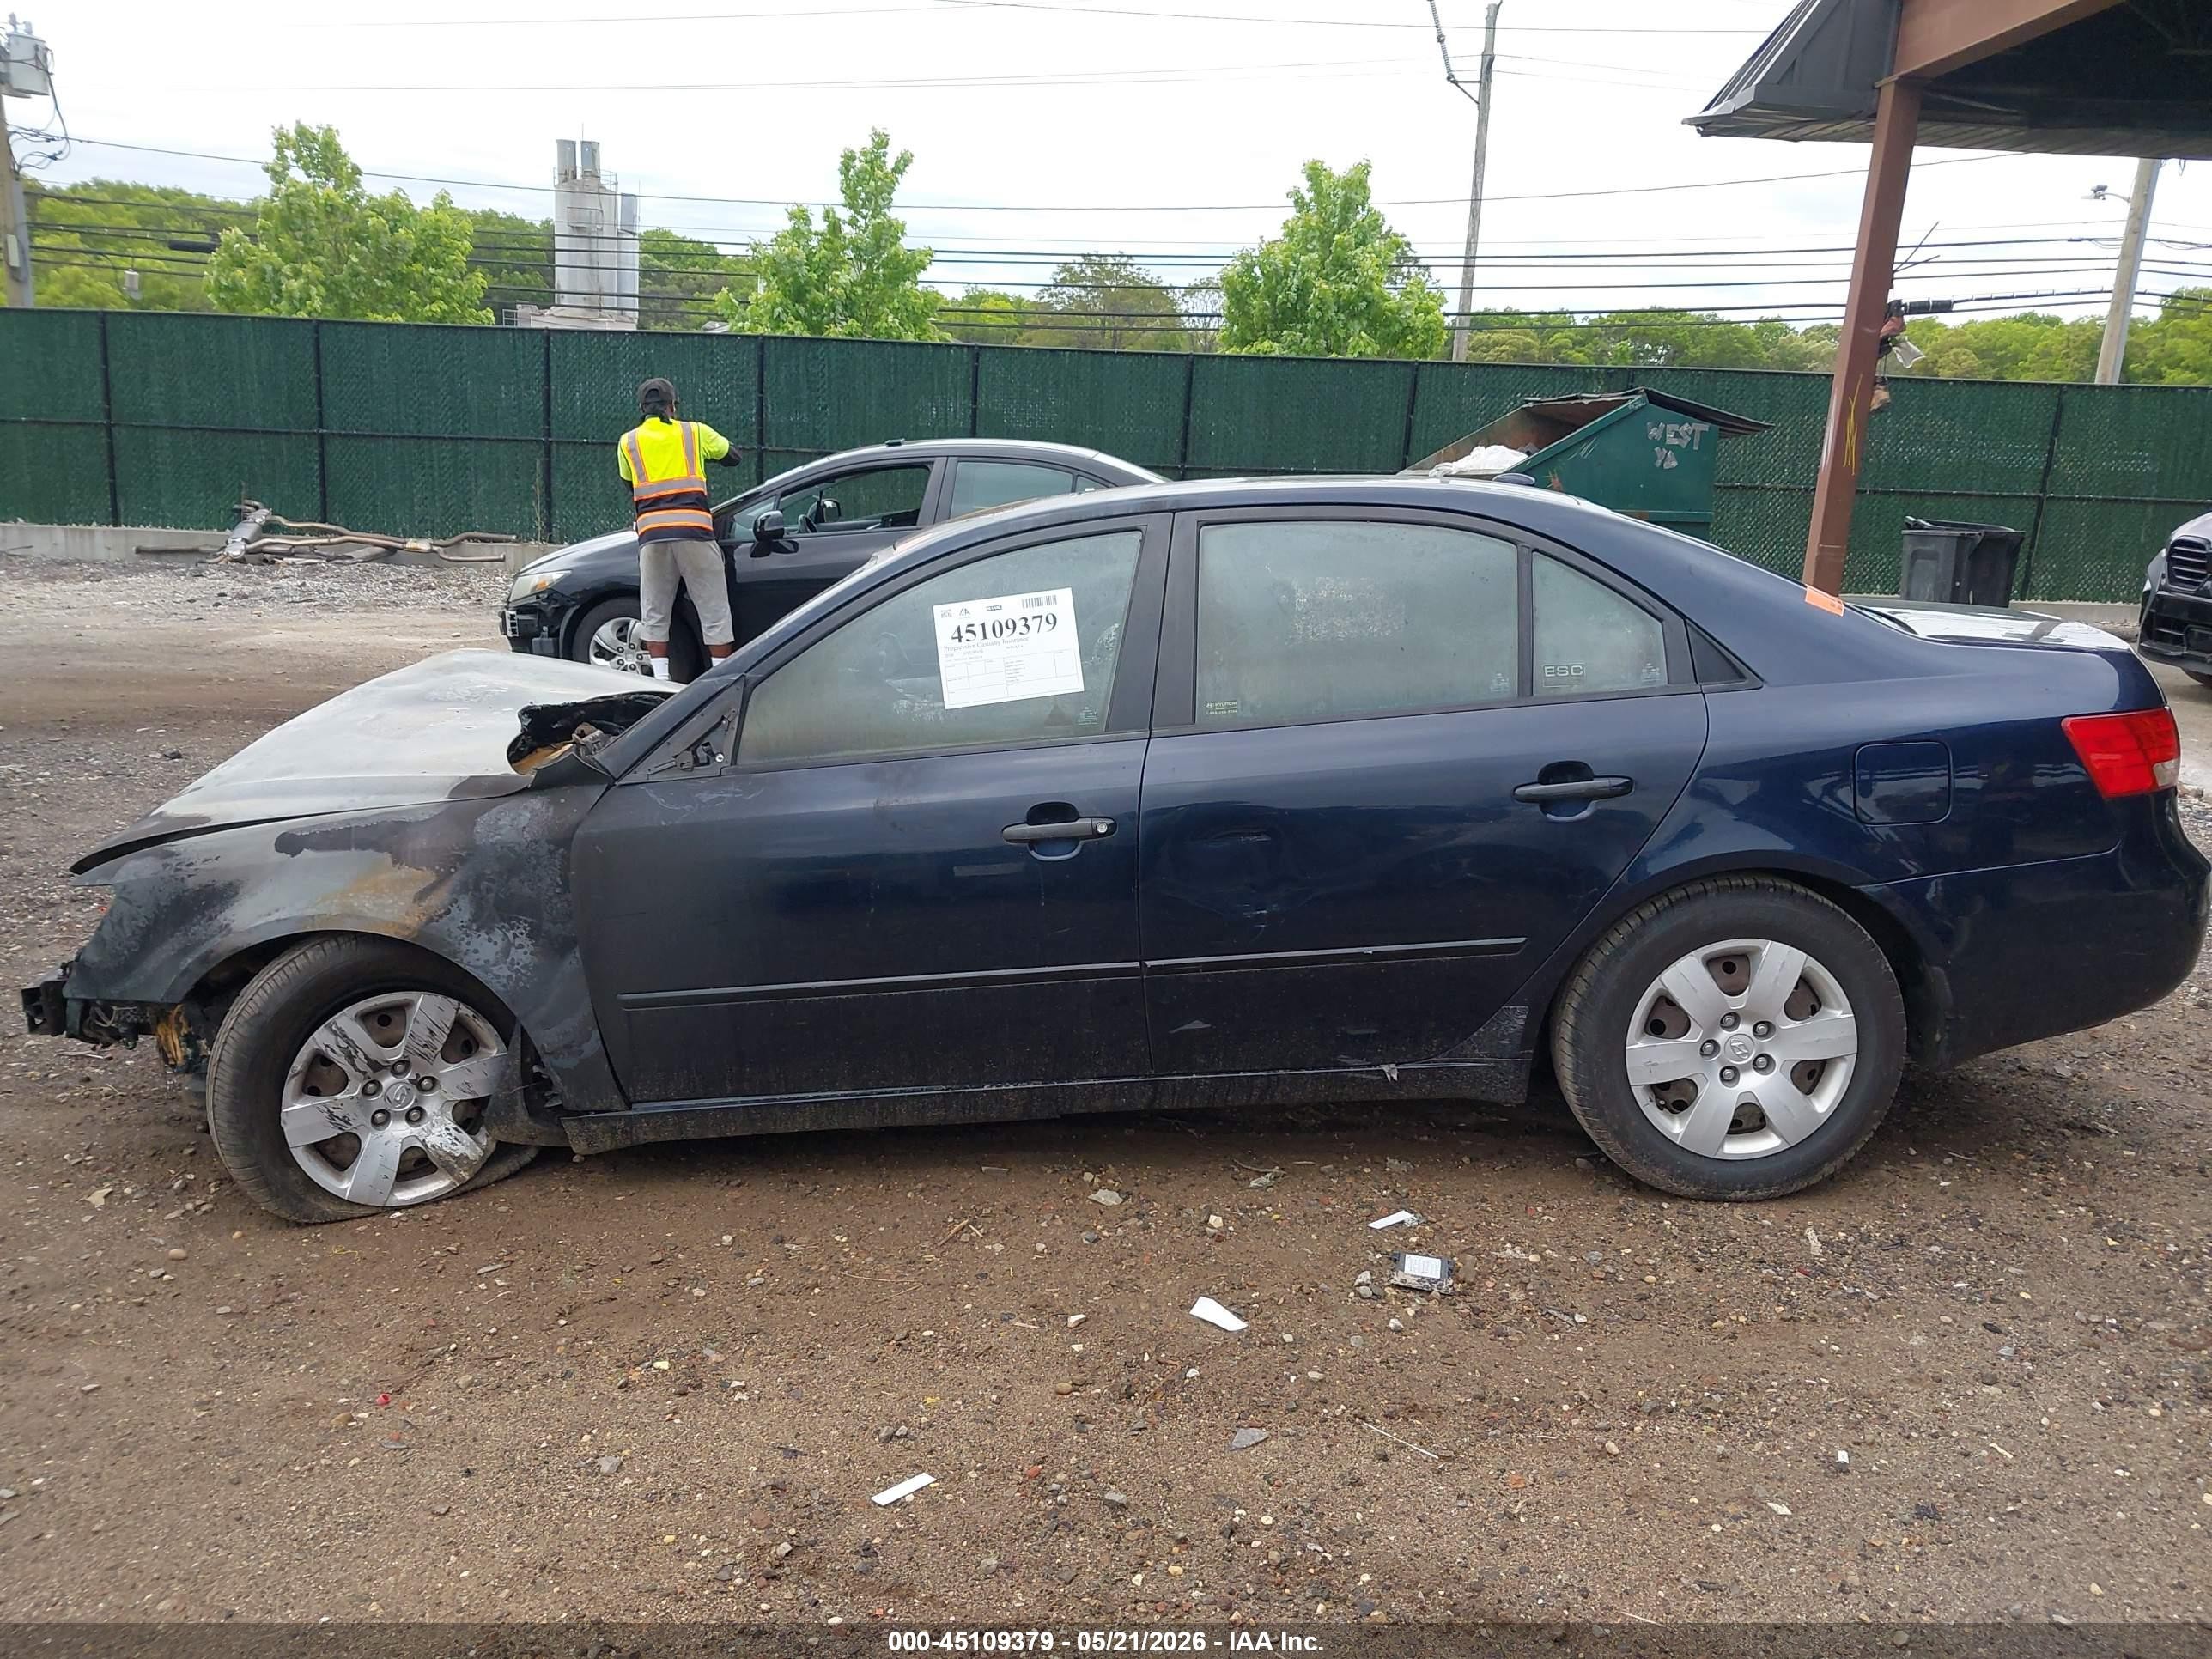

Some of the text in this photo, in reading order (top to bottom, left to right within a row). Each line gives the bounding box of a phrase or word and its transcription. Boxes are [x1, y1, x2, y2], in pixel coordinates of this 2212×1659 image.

[1646, 422, 1710, 451] WEST
[951, 612, 1057, 643] 45109379
[1544, 665, 1583, 677] ESC
